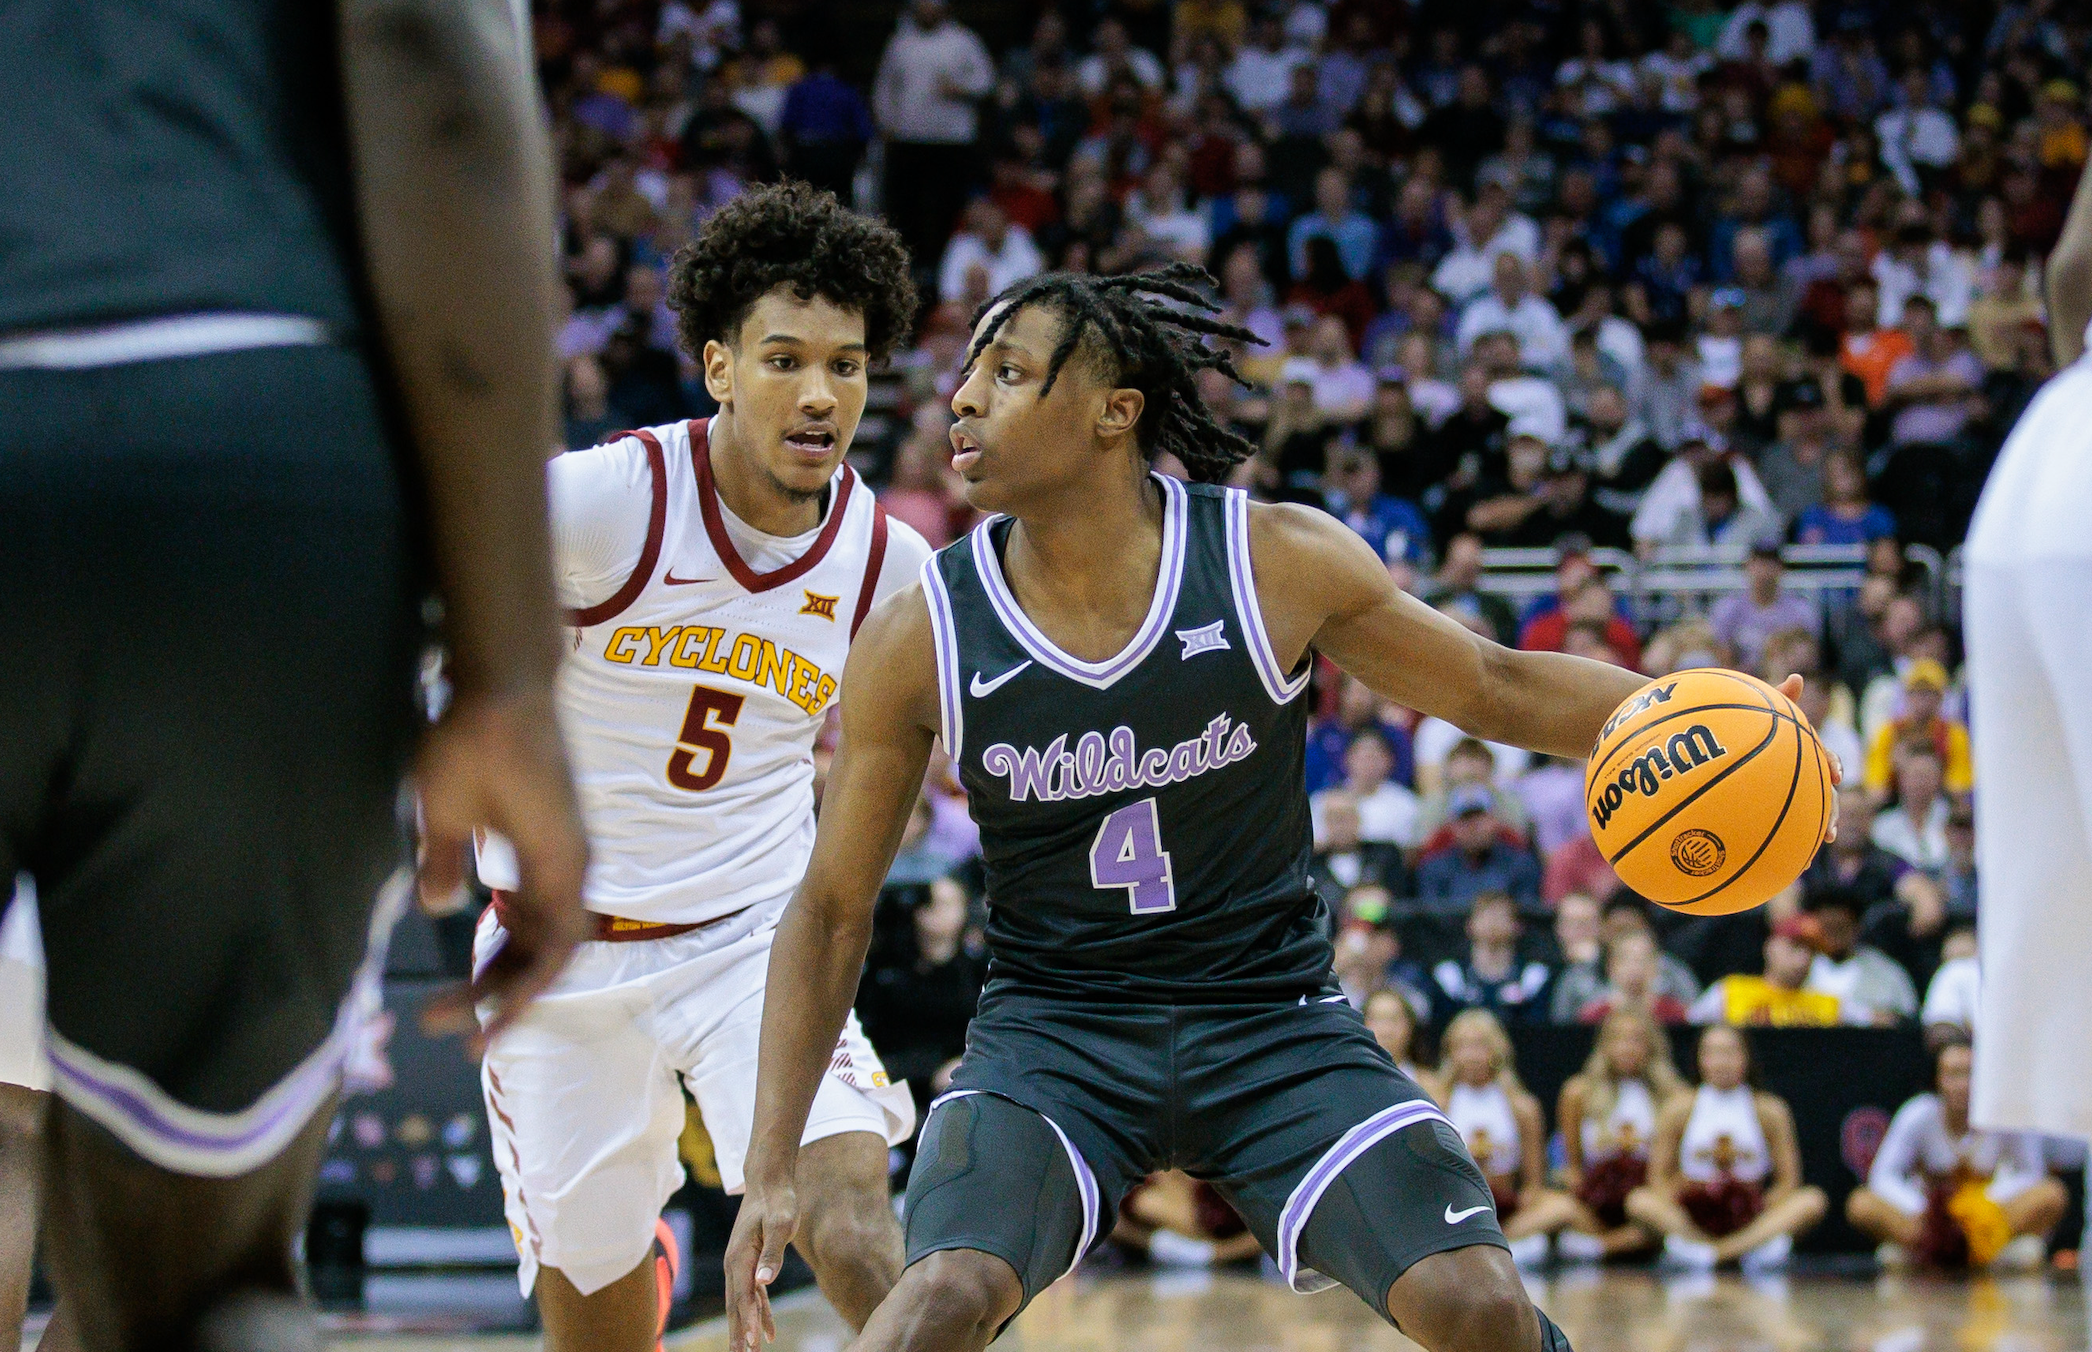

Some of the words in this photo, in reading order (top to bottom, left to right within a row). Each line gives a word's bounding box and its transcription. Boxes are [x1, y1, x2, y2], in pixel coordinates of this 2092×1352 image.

[800, 589, 840, 622] XII
[1175, 620, 1231, 661] XII
[604, 625, 837, 716] CYCLONES
[666, 683, 746, 792] 5
[982, 711, 1257, 802] Wildcats
[1592, 724, 1728, 831] Wilson
[1089, 797, 1176, 915] 4
